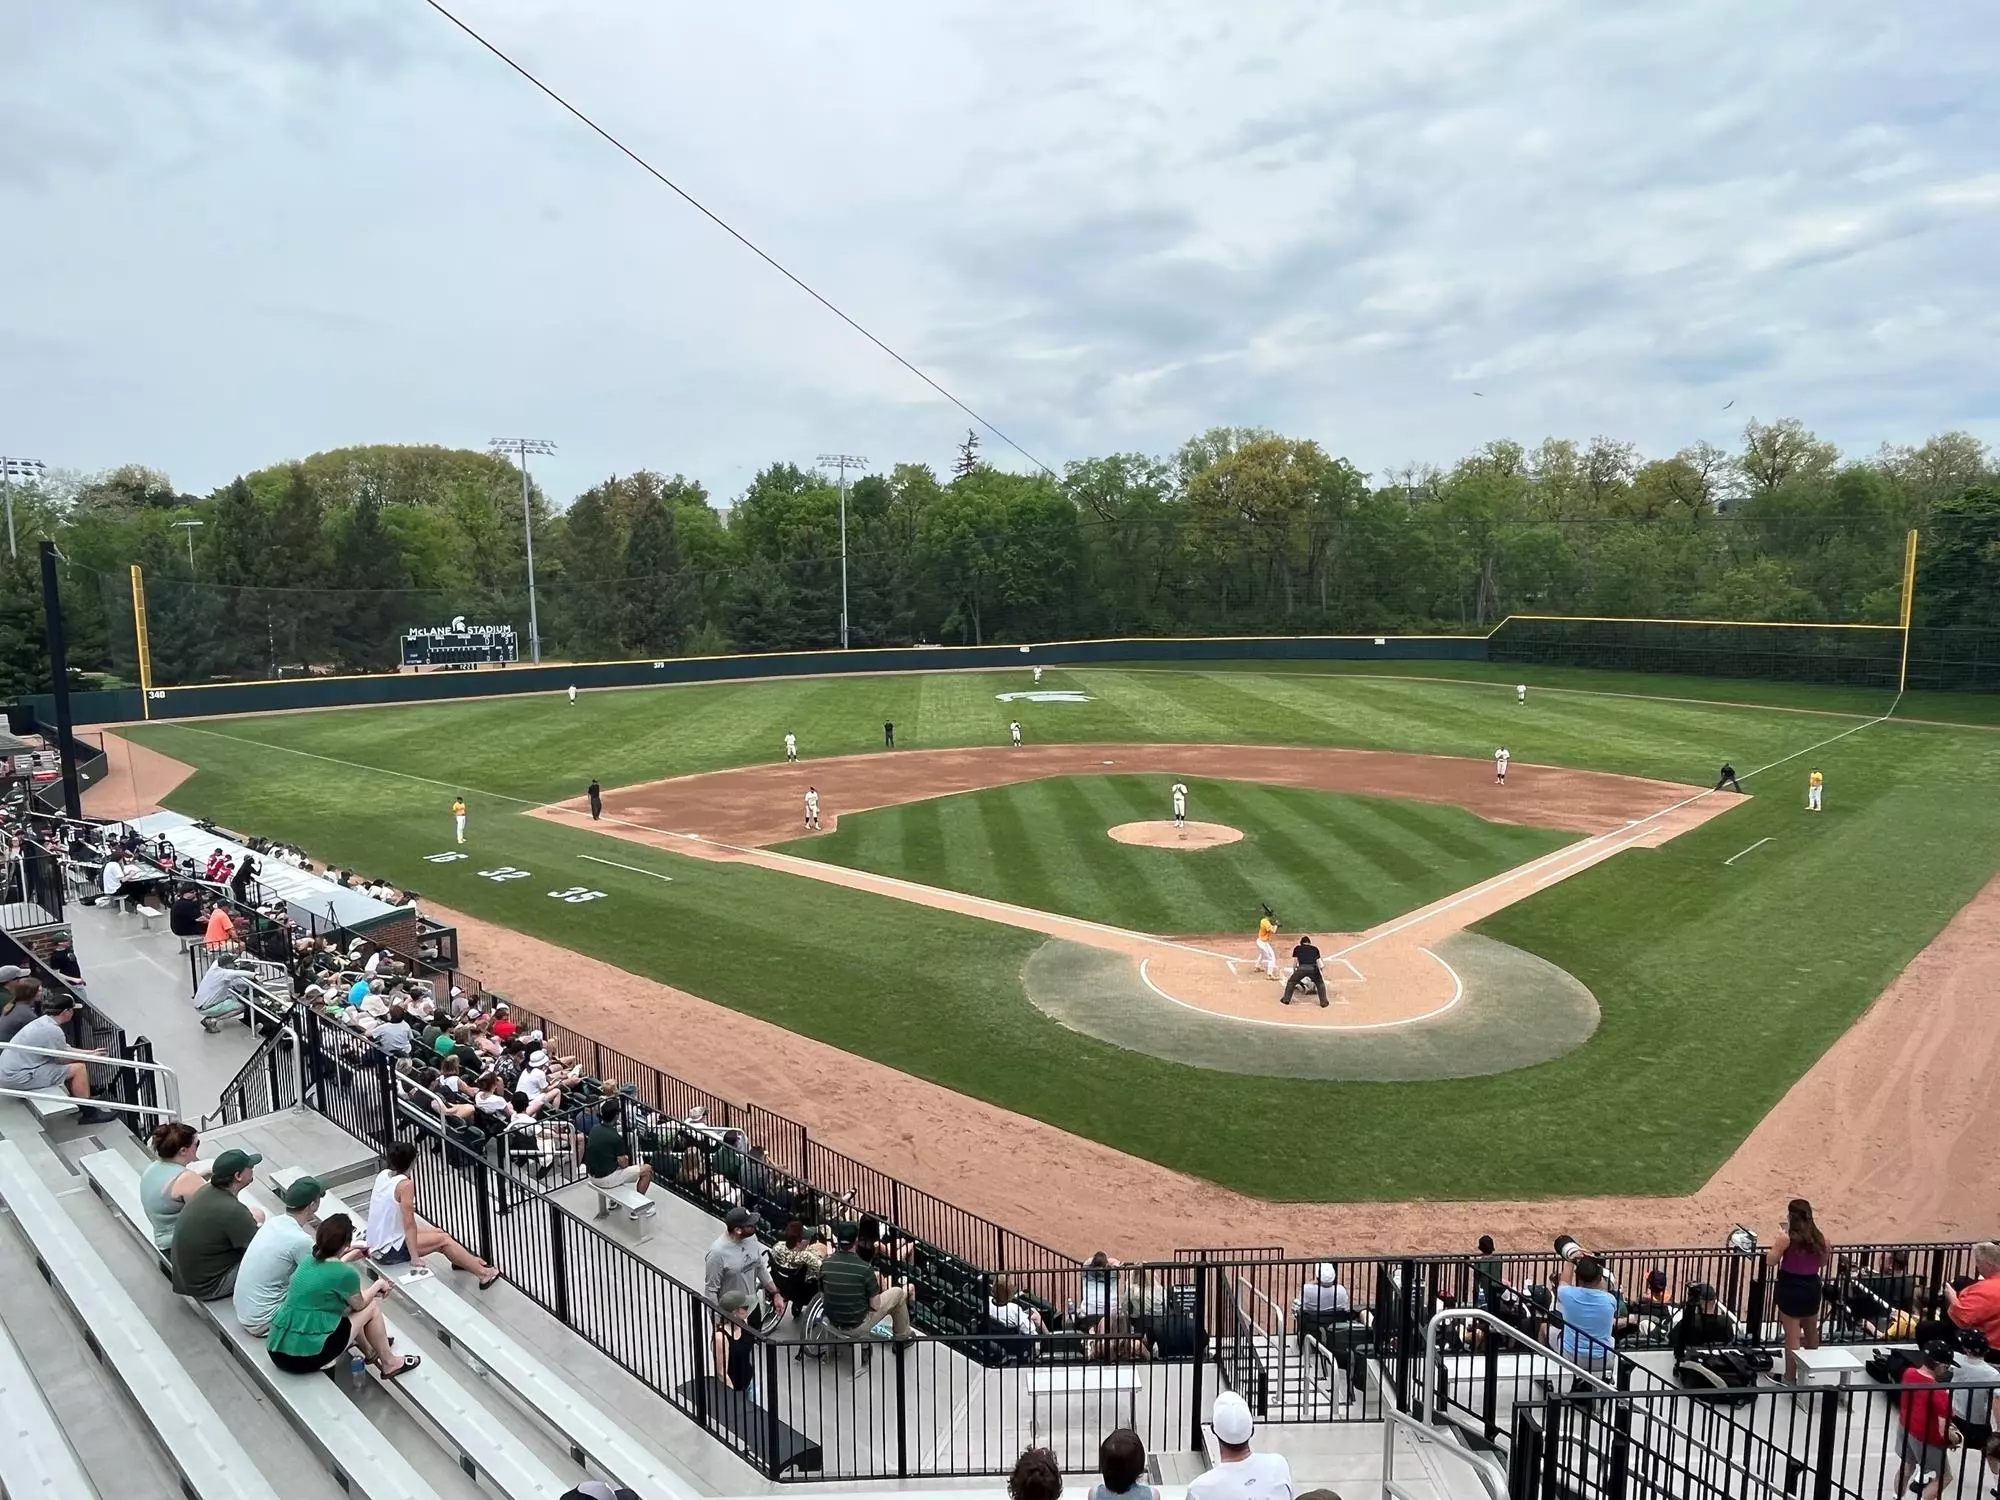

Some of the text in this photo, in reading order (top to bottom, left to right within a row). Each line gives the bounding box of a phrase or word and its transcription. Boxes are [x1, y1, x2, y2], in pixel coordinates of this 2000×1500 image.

[409, 625, 511, 636] McLANE STADIUM
[148, 690, 166, 699] 340
[423, 851, 469, 863] 16
[477, 866, 532, 882] 32
[547, 886, 609, 903] 35
